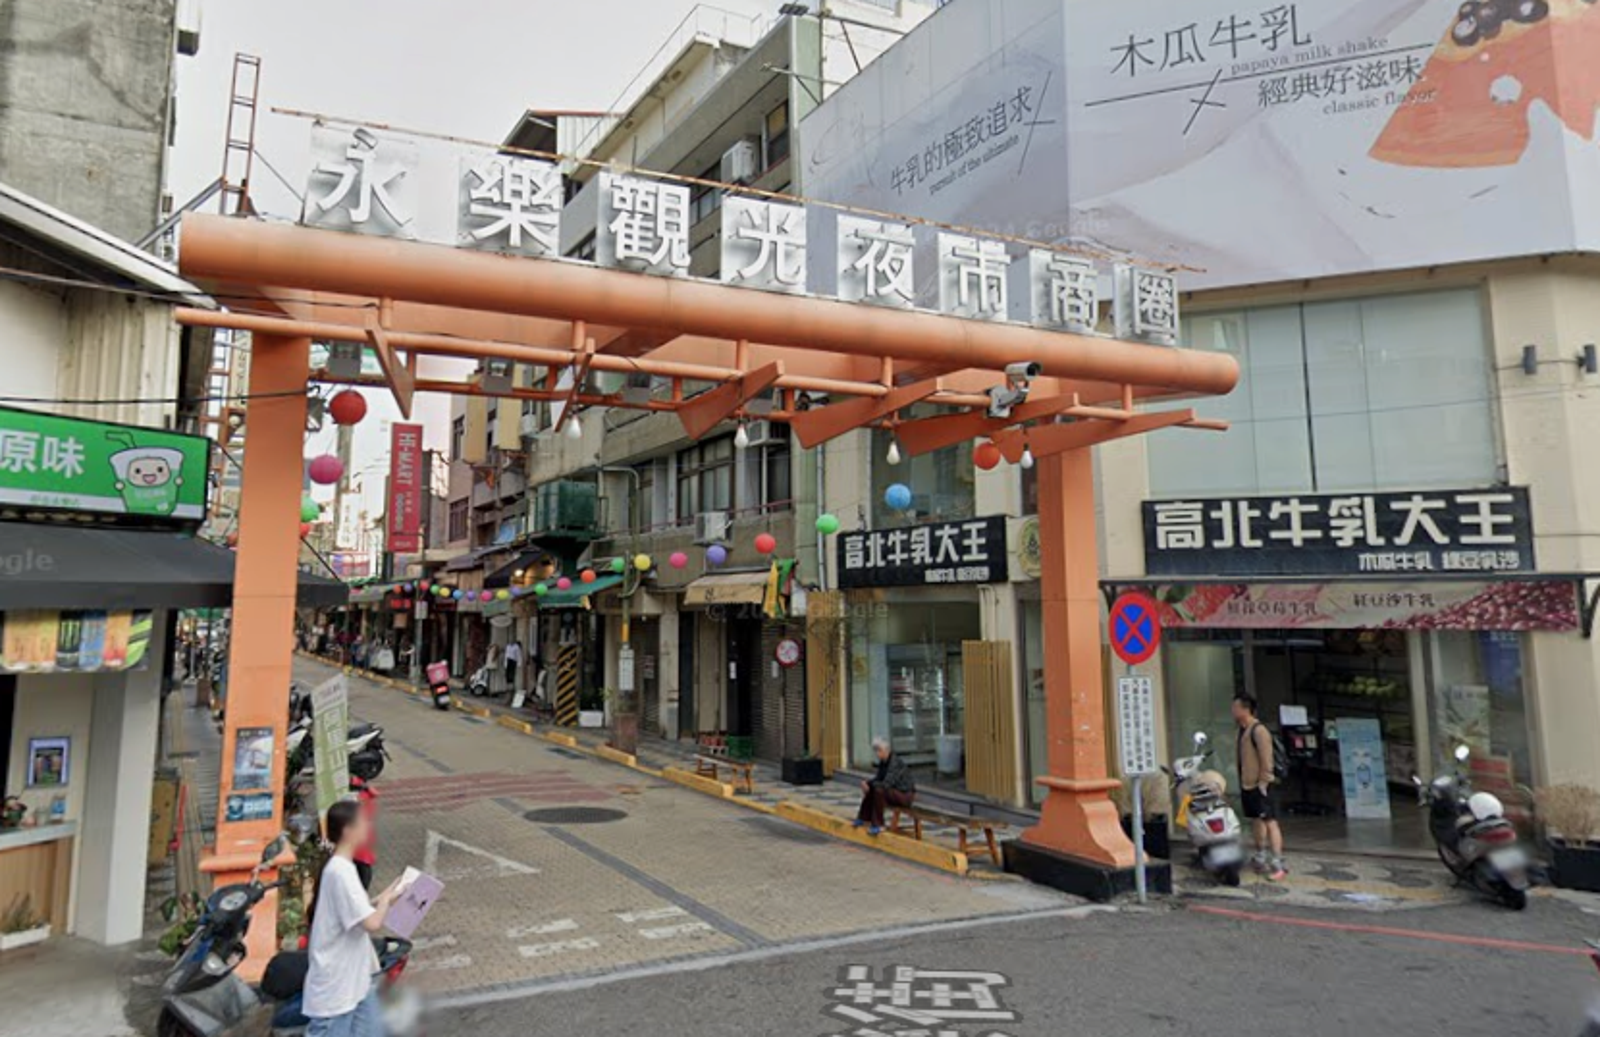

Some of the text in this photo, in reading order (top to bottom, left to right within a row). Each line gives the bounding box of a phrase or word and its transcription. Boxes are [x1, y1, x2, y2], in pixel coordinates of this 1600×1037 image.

[1110, 3, 1312, 77] 木瓜牛乳
[1231, 35, 1389, 75] papaya milk shake
[1258, 55, 1426, 107] 經典好滋味
[1322, 88, 1436, 115] classic flavor
[891, 86, 1032, 196] 牛乳的極致追求
[312, 127, 1180, 340] 永樂觀光夜市商圈
[0, 429, 85, 479] 原味
[844, 521, 989, 570] 高北牛乳大王
[1154, 494, 1517, 549] 高北牛乳大王
